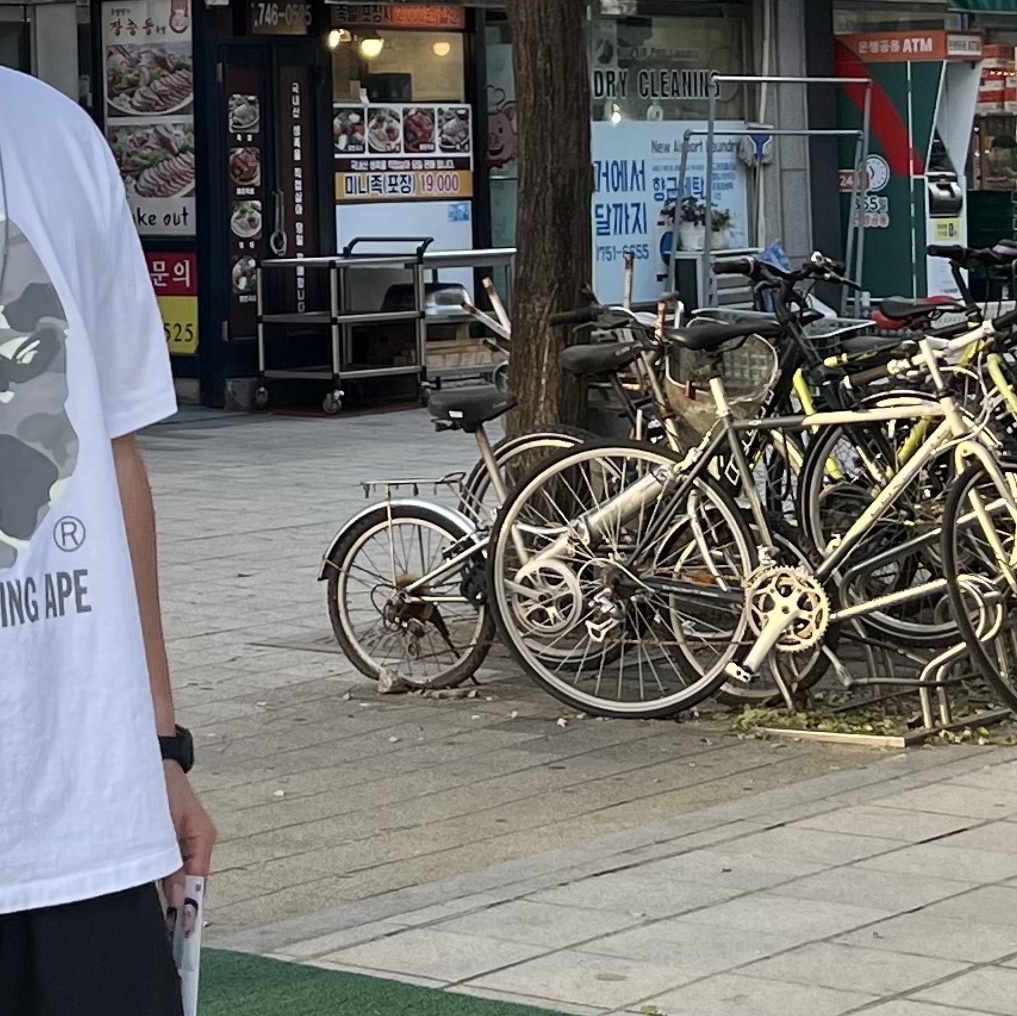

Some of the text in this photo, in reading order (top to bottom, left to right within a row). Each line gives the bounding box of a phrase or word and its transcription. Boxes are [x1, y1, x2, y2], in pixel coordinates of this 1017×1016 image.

[902, 37, 934, 53] ATM
[593, 70, 628, 98] DRY
[163, 206, 189, 226] out
[150, 259, 191, 288] 문의
[44, 568, 93, 620] APE
